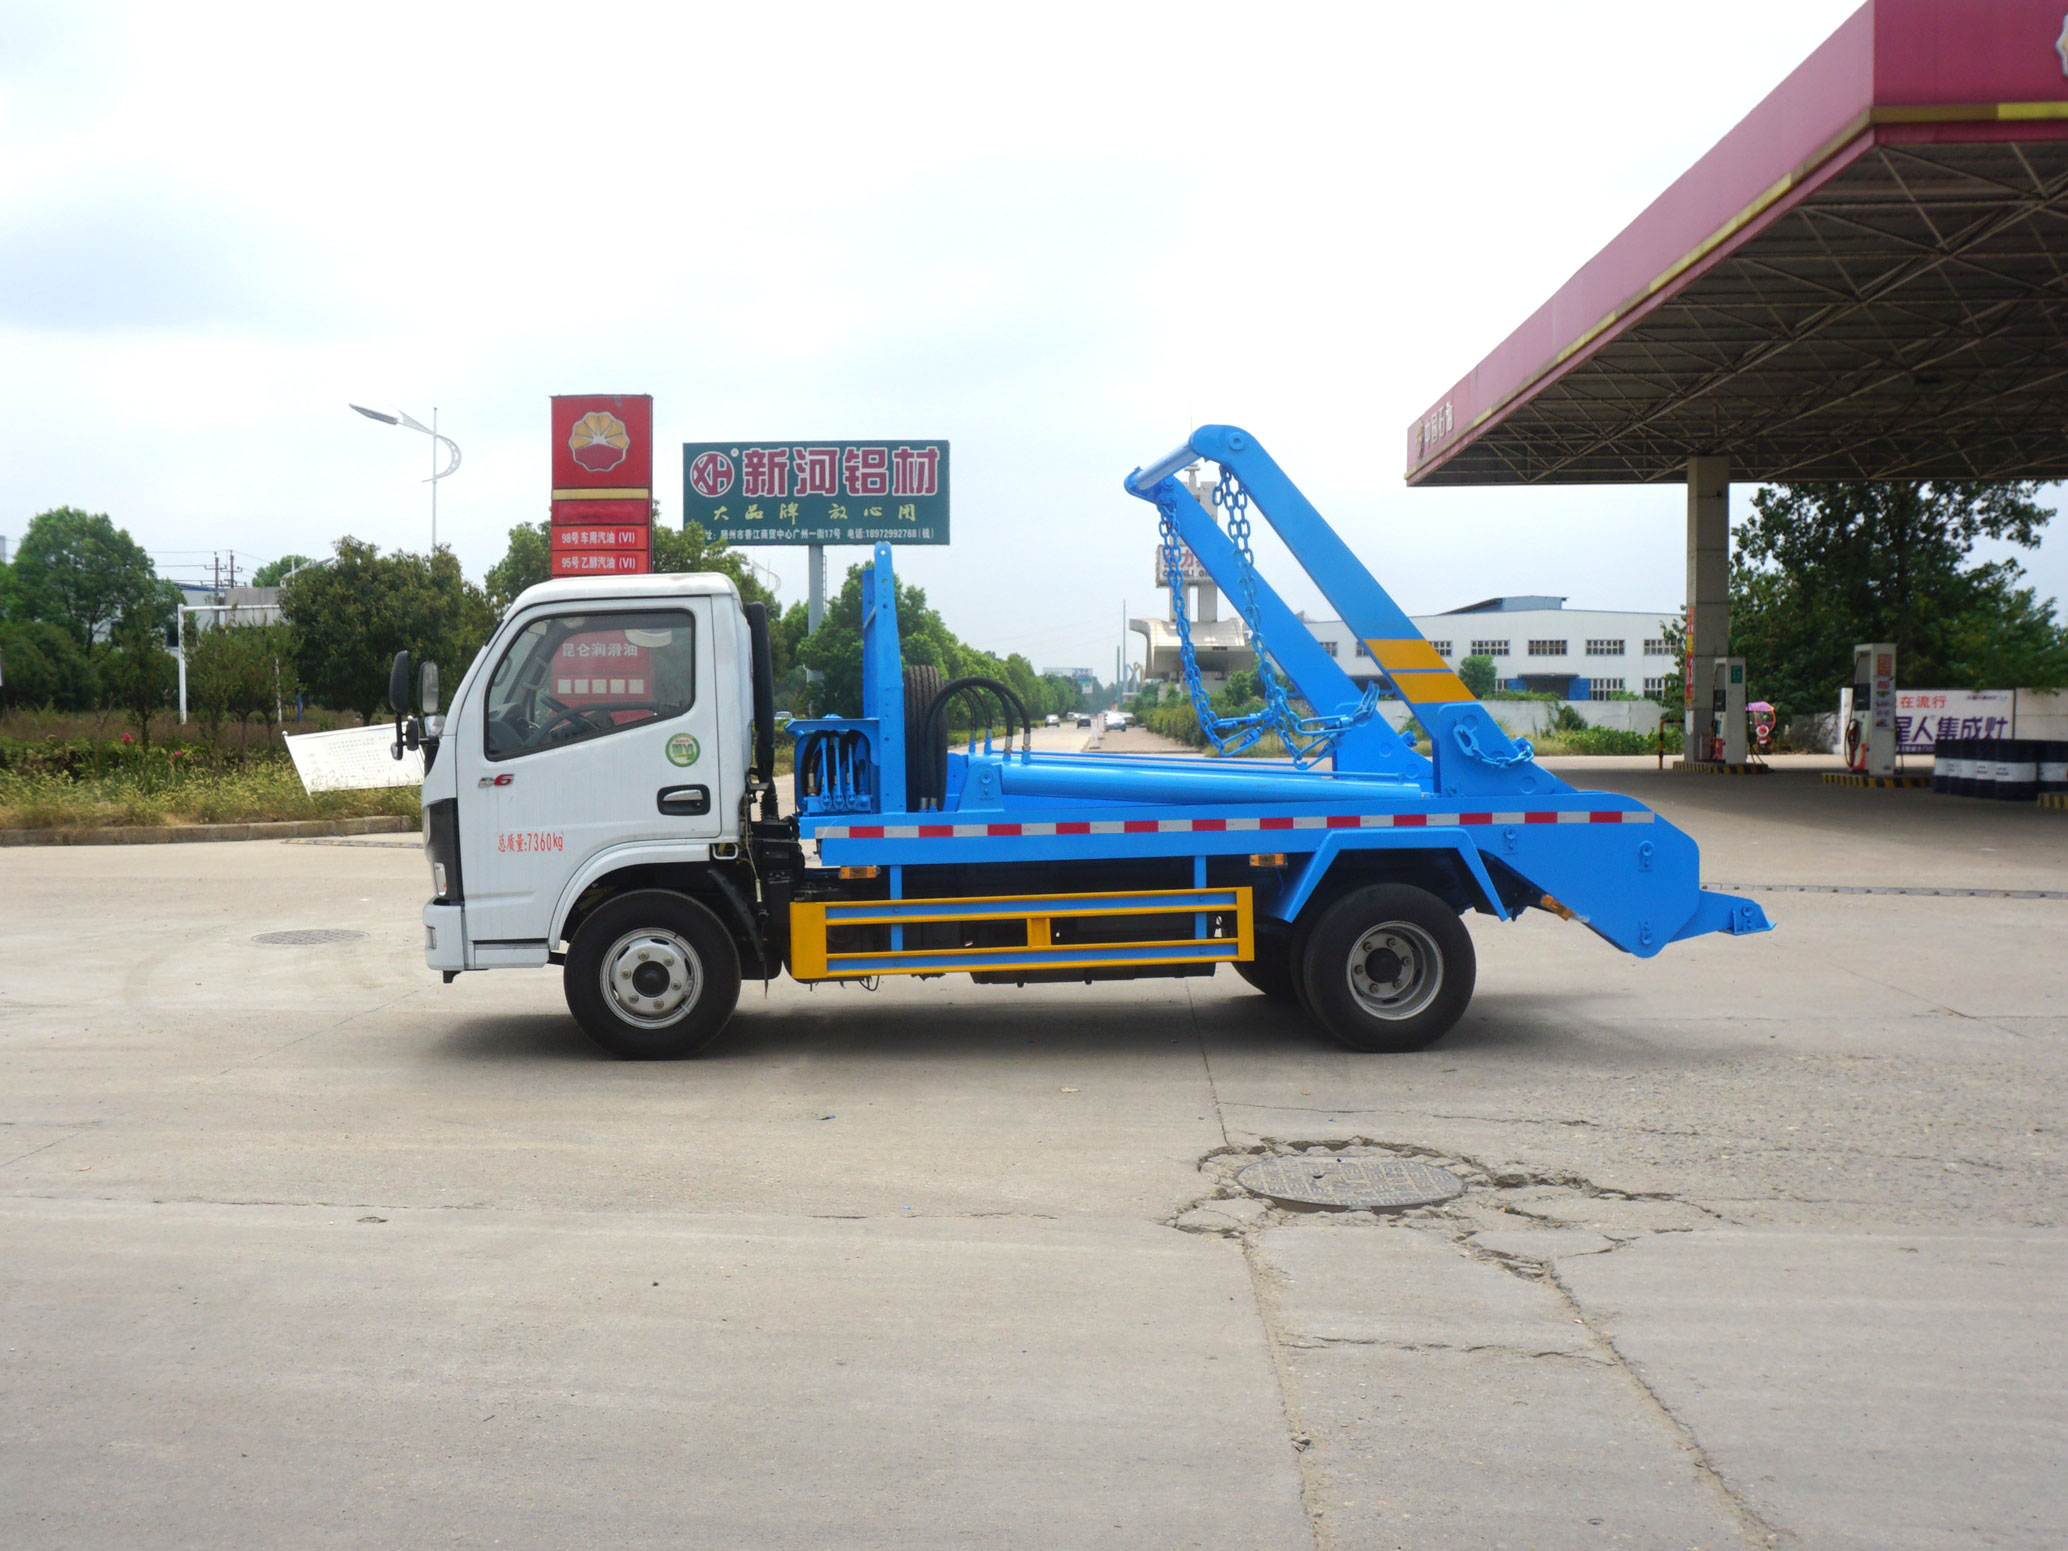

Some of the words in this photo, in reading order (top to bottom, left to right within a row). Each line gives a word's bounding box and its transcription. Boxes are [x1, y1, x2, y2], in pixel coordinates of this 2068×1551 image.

[742, 446, 940, 498] 新河铝材
[713, 502, 799, 526] 大品牌
[828, 502, 916, 522] 放心用
[580, 531, 615, 545] 车用汽油
[561, 556, 579, 569] 95号
[581, 556, 616, 569] 乙醇汽油
[562, 642, 638, 657] 昆仑润滑油
[1895, 695, 1947, 709] 在流行
[497, 832, 564, 853] 总质量:7360kg
